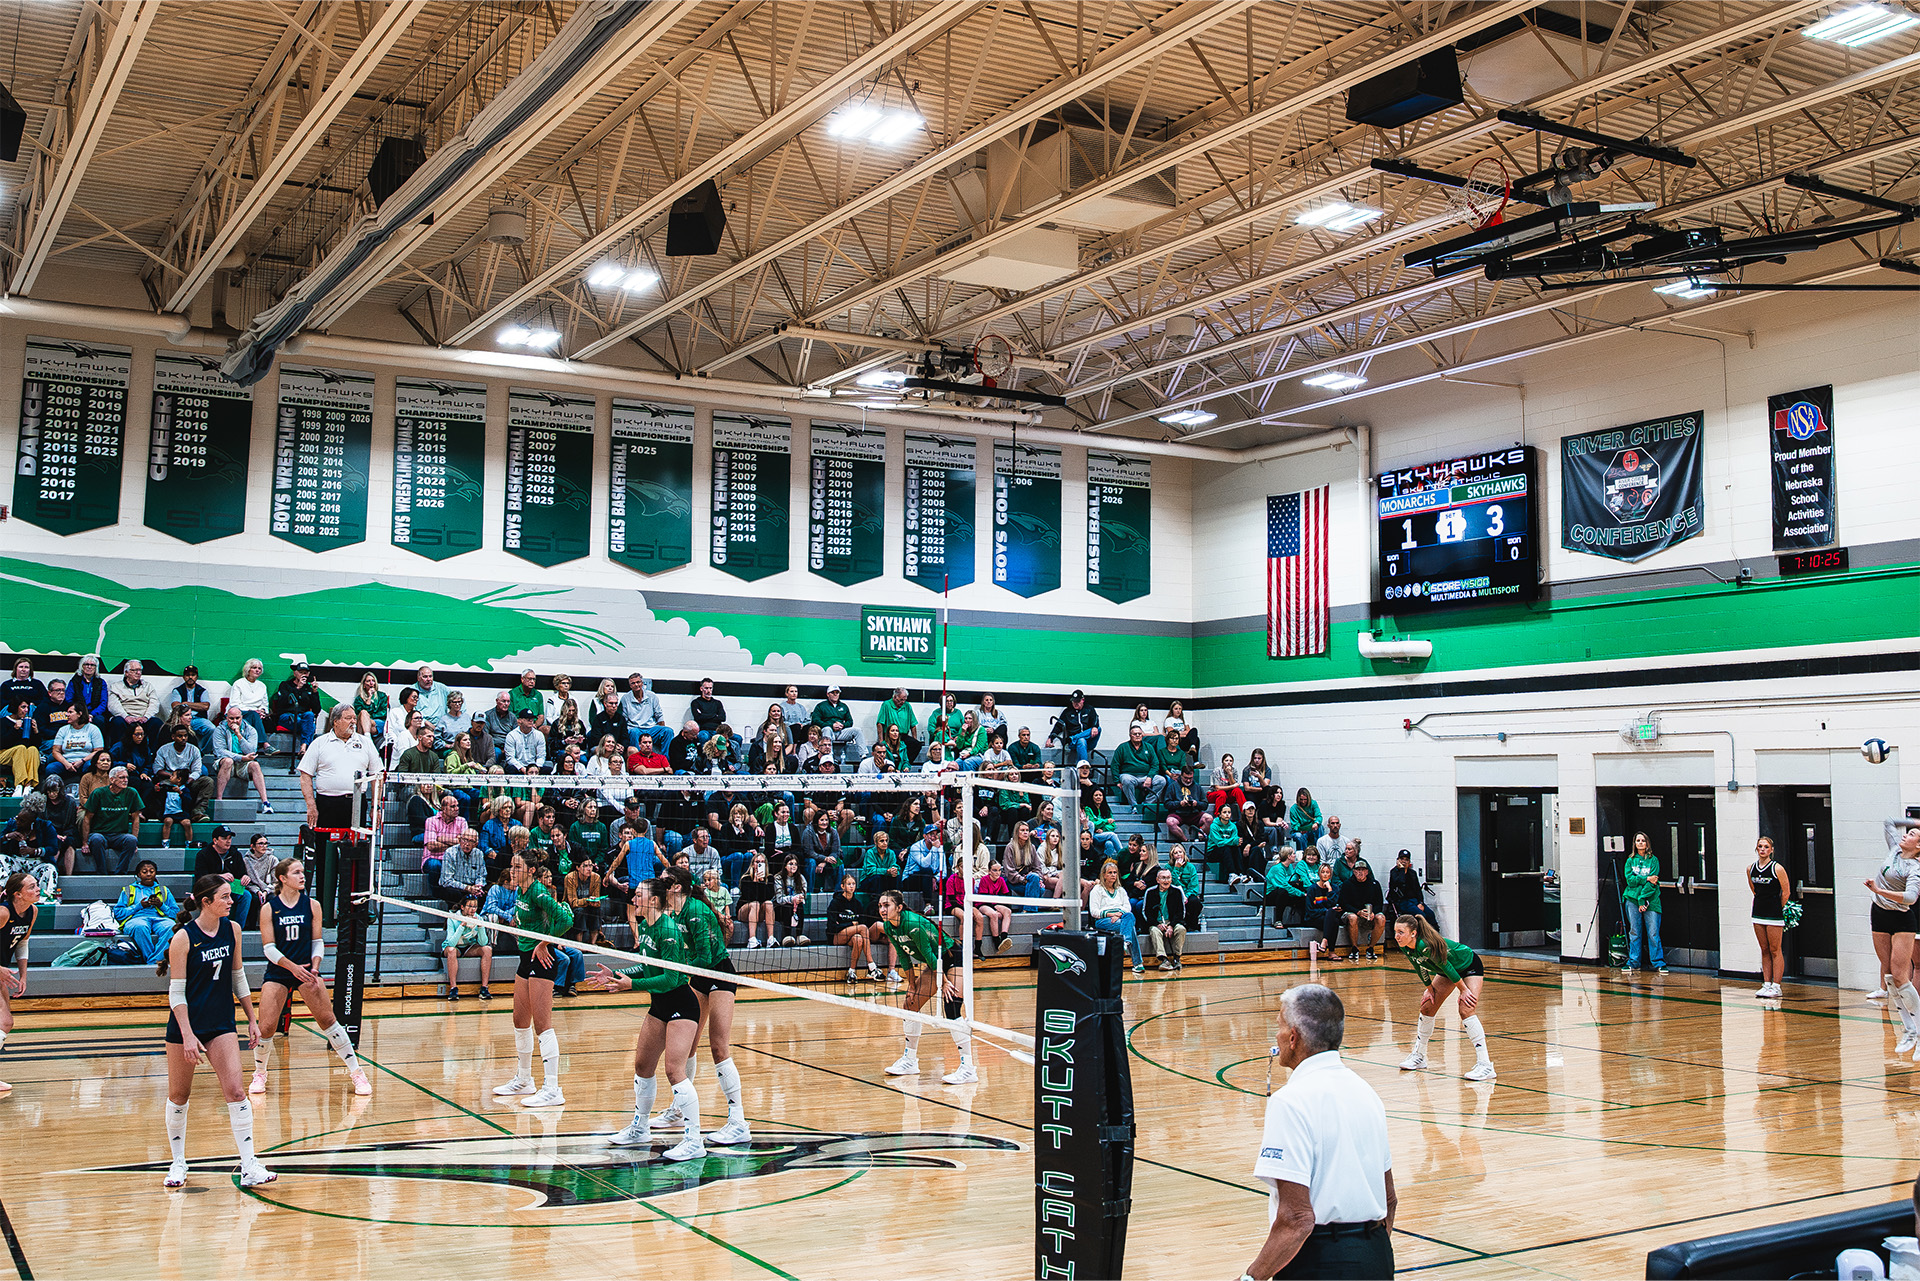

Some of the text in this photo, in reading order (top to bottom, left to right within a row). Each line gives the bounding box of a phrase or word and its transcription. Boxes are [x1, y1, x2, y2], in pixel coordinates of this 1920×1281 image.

[26, 358, 129, 374] SKYHAWKS
[27, 371, 126, 387] CHAMPIONSHIPS
[48, 384, 123, 400] 2008 2018
[48, 396, 122, 411] 2009 2019
[177, 397, 210, 408] 2008
[46, 408, 121, 422] 2010 2020
[176, 408, 208, 419] 2010
[302, 409, 370, 423] 1998 2009 2026
[18, 382, 44, 476] DANCE
[45, 419, 118, 434] 2011 2021
[175, 420, 208, 430] 2016
[301, 421, 345, 433] 1999 2010
[418, 421, 446, 430] 2013
[44, 430, 119, 446] 2012 2022
[150, 395, 172, 481] CHEER
[174, 432, 207, 442] 2017
[300, 432, 344, 444] 2000 2012
[418, 432, 446, 441] 2014
[529, 431, 556, 440] 2006
[1568, 417, 1696, 457] RIVER CITIES
[43, 442, 118, 456] 2013 2023
[174, 444, 206, 455] 2018
[299, 444, 319, 453] 2001
[417, 443, 446, 453] 2015
[528, 442, 556, 451] 2007
[631, 445, 657, 455] 2025
[42, 454, 77, 464] 2014
[417, 454, 446, 464] 2018
[527, 453, 556, 463] 2014
[732, 452, 757, 461] 2002
[1774, 446, 1831, 462] Proud Member
[173, 457, 206, 468] 2019
[298, 455, 343, 466] 2002 2014
[829, 460, 853, 469] 2006
[42, 466, 76, 476] 2015
[273, 407, 297, 532] BOYS WRESTLING
[417, 466, 446, 475] 2023
[527, 464, 556, 473] 2020
[732, 462, 757, 471] 2006
[1380, 450, 1524, 487] SKYHAWKS
[1790, 463, 1814, 474] of the
[298, 467, 342, 478] 2003 2015
[731, 472, 756, 481] 2007
[829, 470, 853, 478] 2009
[41, 478, 76, 488] 2016
[297, 478, 342, 490] 2004 2016
[394, 419, 413, 544] BOYS WRESTLING DUALS
[416, 476, 446, 486] 2024
[527, 474, 555, 484] 2023
[829, 480, 853, 488] 2010
[922, 480, 945, 488] 2004
[1785, 477, 1823, 490] Nebraska
[505, 429, 525, 548] BOYS BASKETBALL
[526, 484, 554, 494] 2024
[731, 482, 756, 491] 2008
[1102, 487, 1123, 495] 2017
[1467, 478, 1525, 498] SKYHAWKS
[40, 490, 74, 500] 2017
[296, 490, 341, 501] 2005 2017
[416, 488, 445, 497] 2025
[731, 492, 756, 501] 2009
[828, 490, 852, 498] 2011
[922, 489, 945, 498] 2007
[416, 499, 445, 508] 2026
[526, 495, 554, 505] 2025
[610, 444, 628, 553] GIRLS BASKETBALL
[922, 499, 945, 507] 2008
[1102, 496, 1123, 504] 2026
[1381, 493, 1436, 513] MONARCHS
[1791, 492, 1818, 505] School
[296, 501, 340, 513] 2006 2018
[712, 451, 729, 564] GIRLS TENNIS
[730, 502, 756, 511] 2010
[730, 512, 756, 521] 2012
[810, 458, 826, 570] GIRLS SOCCER
[828, 509, 852, 518] 2016
[922, 508, 944, 517] 2012
[1788, 508, 1824, 521] Activities
[295, 513, 340, 524] 2007 2023
[828, 519, 852, 527] 2017
[906, 468, 920, 576] BOYS SOCCER
[921, 518, 944, 526] 2019
[1486, 504, 1503, 536] 3
[294, 525, 339, 536] 2008 2025
[730, 523, 756, 531] 2013
[995, 477, 1008, 581] BOYS GOLF
[1447, 521, 1455, 538] 1
[1571, 506, 1698, 544] CONFERENCE
[1784, 523, 1829, 537] Association
[828, 528, 852, 536] 2021
[921, 527, 944, 535] 2021
[1088, 486, 1100, 584] BASEBALL
[1402, 519, 1417, 550] 1
[730, 534, 756, 542] 2014
[827, 537, 852, 545] 2022
[921, 537, 944, 545] 2022
[827, 547, 851, 555] 2023
[921, 546, 944, 554] 2023
[1511, 546, 1519, 560] 0
[921, 556, 944, 564] 2024
[1795, 552, 1840, 568] 7:10:25
[1390, 563, 1396, 576] 0
[1431, 591, 1470, 602] MULTIMEDIA
[1478, 585, 1520, 596] MULTISPORT
[867, 615, 931, 634] SKYHAWK
[870, 635, 928, 652] PARENTS
[280, 914, 304, 926] MERCY
[10, 925, 29, 936] MERCY
[285, 925, 299, 940] 10
[9, 935, 20, 948] 5
[201, 945, 230, 962] MERCY
[212, 960, 222, 980] 7
[344, 964, 354, 1015] sports imports
[1041, 1009, 1076, 1149] SKUTT
[1042, 1171, 1075, 1281] CATH
